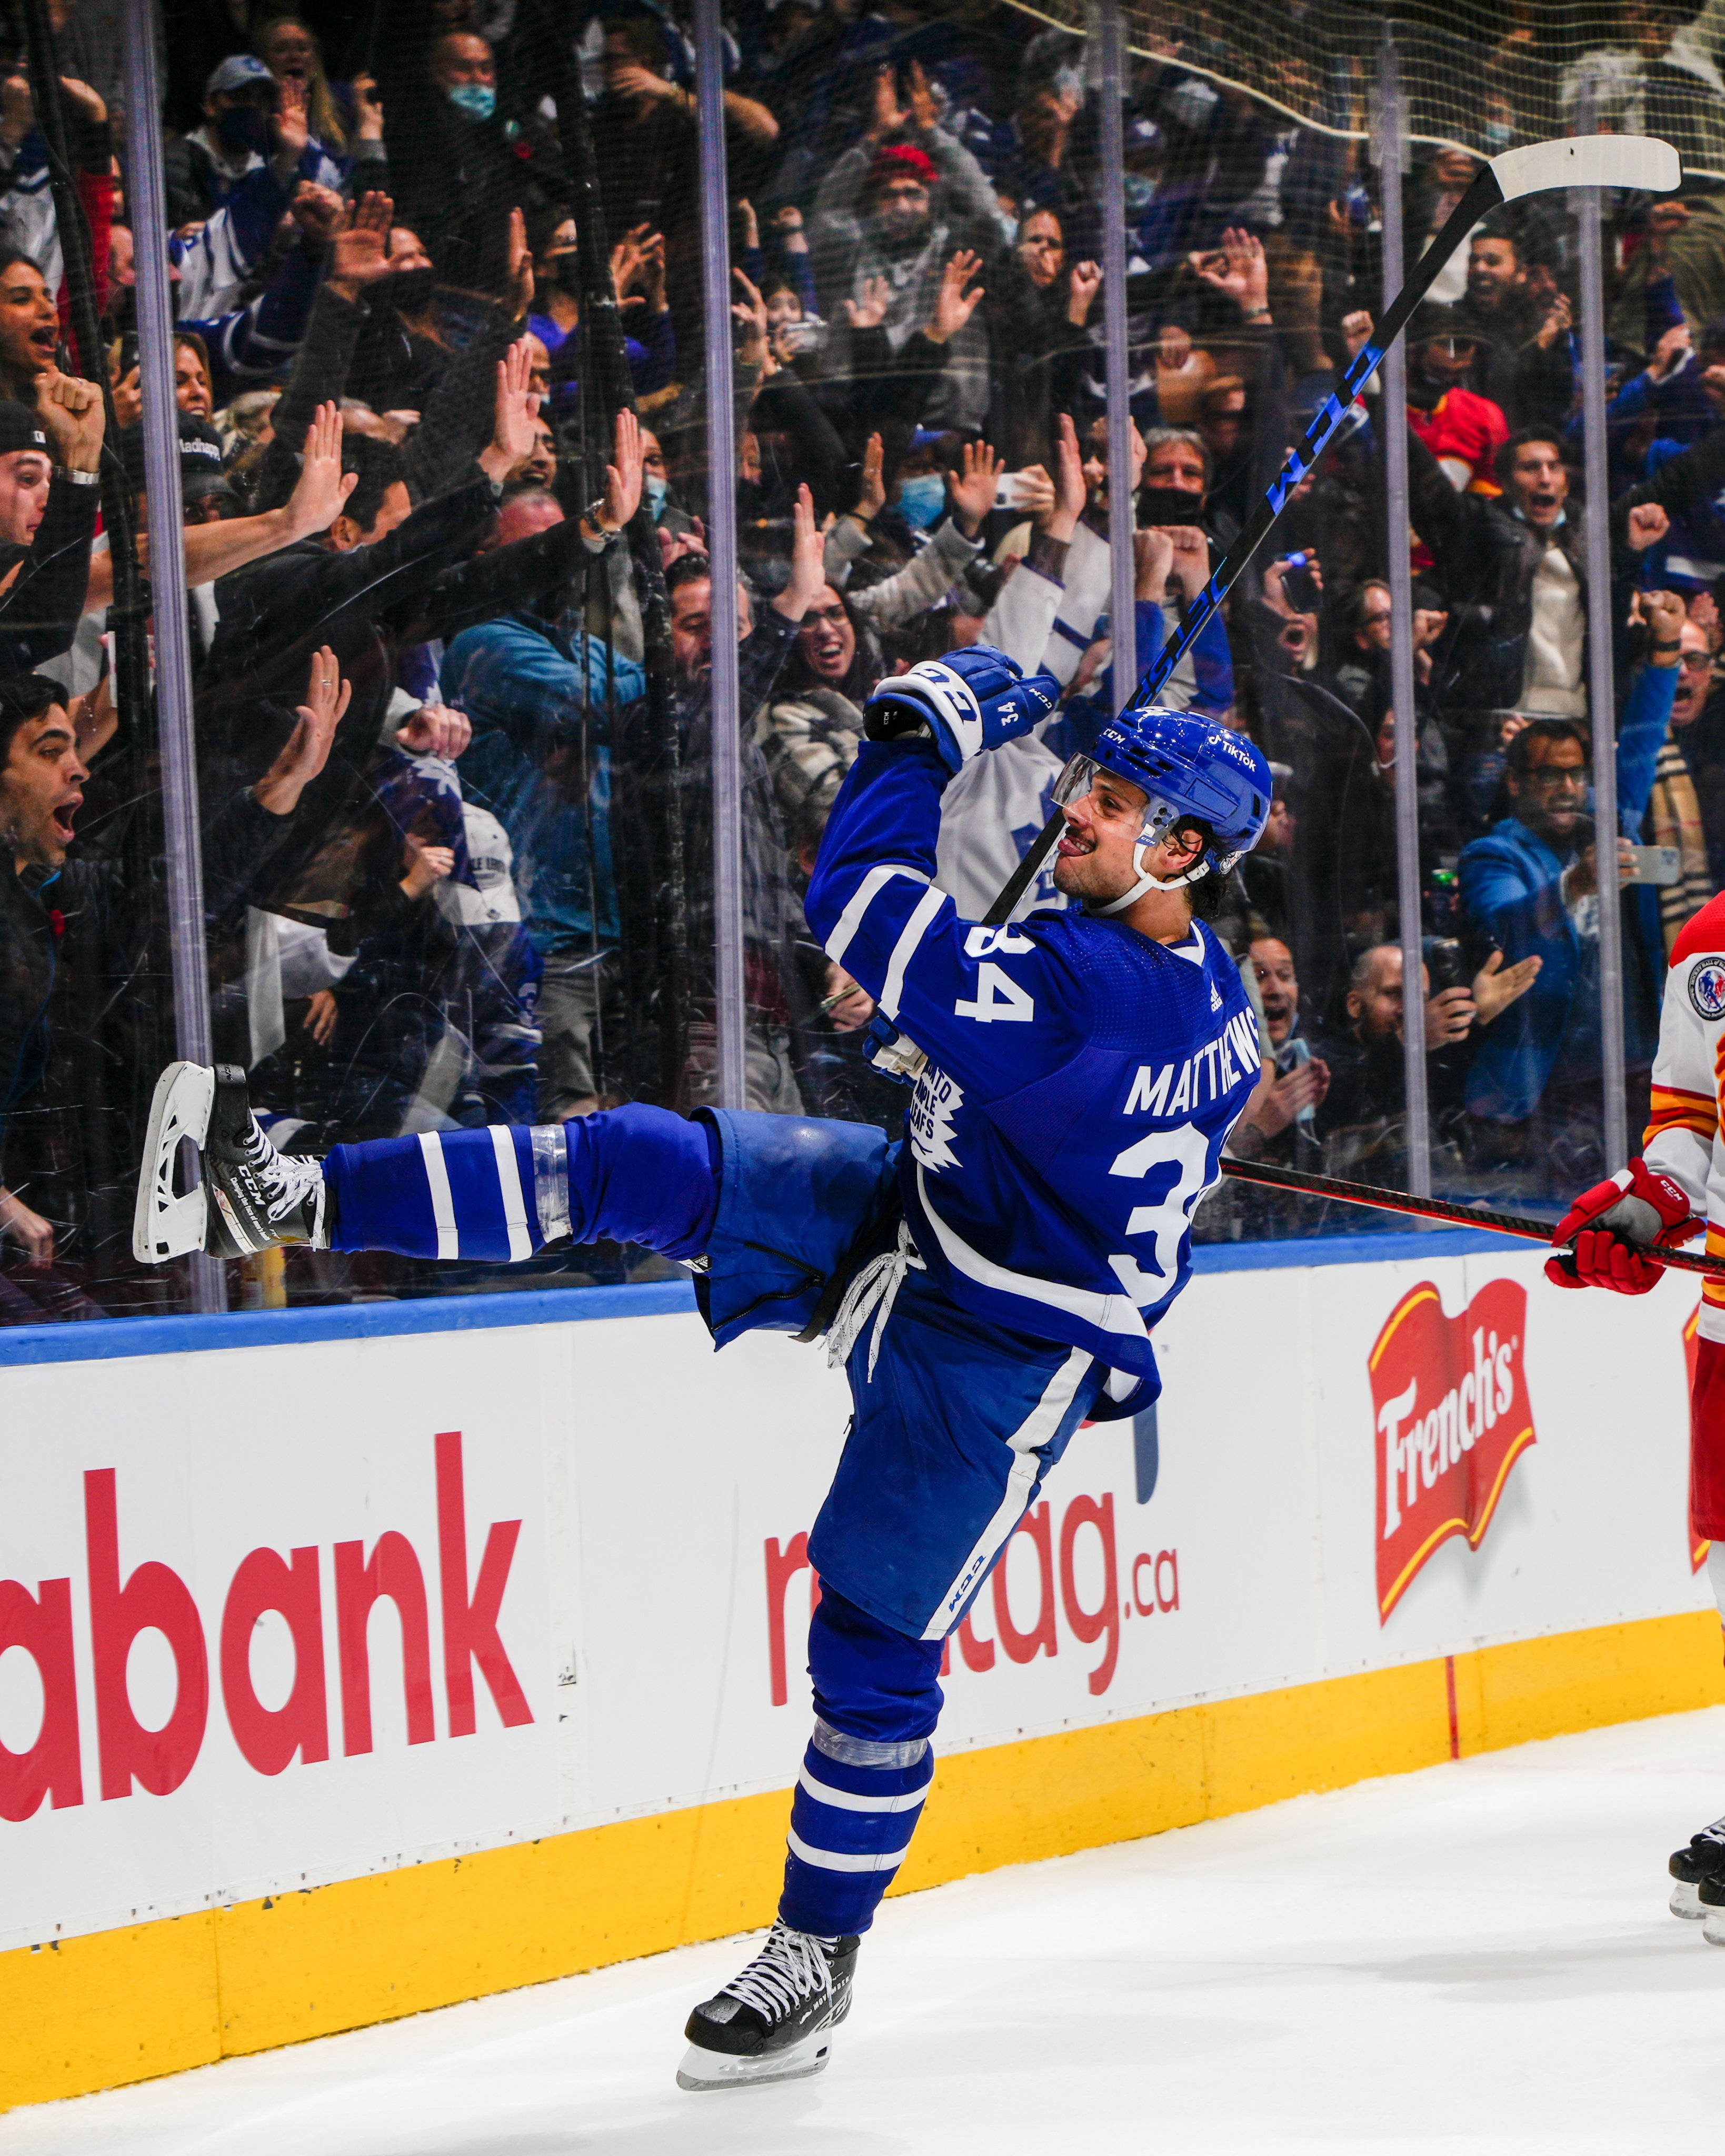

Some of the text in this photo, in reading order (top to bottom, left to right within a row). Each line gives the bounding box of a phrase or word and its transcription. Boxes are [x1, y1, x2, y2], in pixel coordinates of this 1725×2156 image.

[1265, 341, 1385, 516] CCM
[997, 701, 1019, 727] 34
[1029, 687, 1052, 710] CCM
[1103, 727, 1126, 744] CCM
[1222, 742, 1257, 773] TikTok
[1141, 836, 1156, 845] CCM
[954, 924, 1036, 1023] 34
[238, 1164, 266, 1205] CCM
[1660, 1180, 1683, 1201] CCM
[1108, 1116, 1232, 1308] 3
[1378, 1326, 1514, 1540] French's
[949, 1555, 986, 1612] CCM
[813, 1975, 849, 2011] MOVMBER
